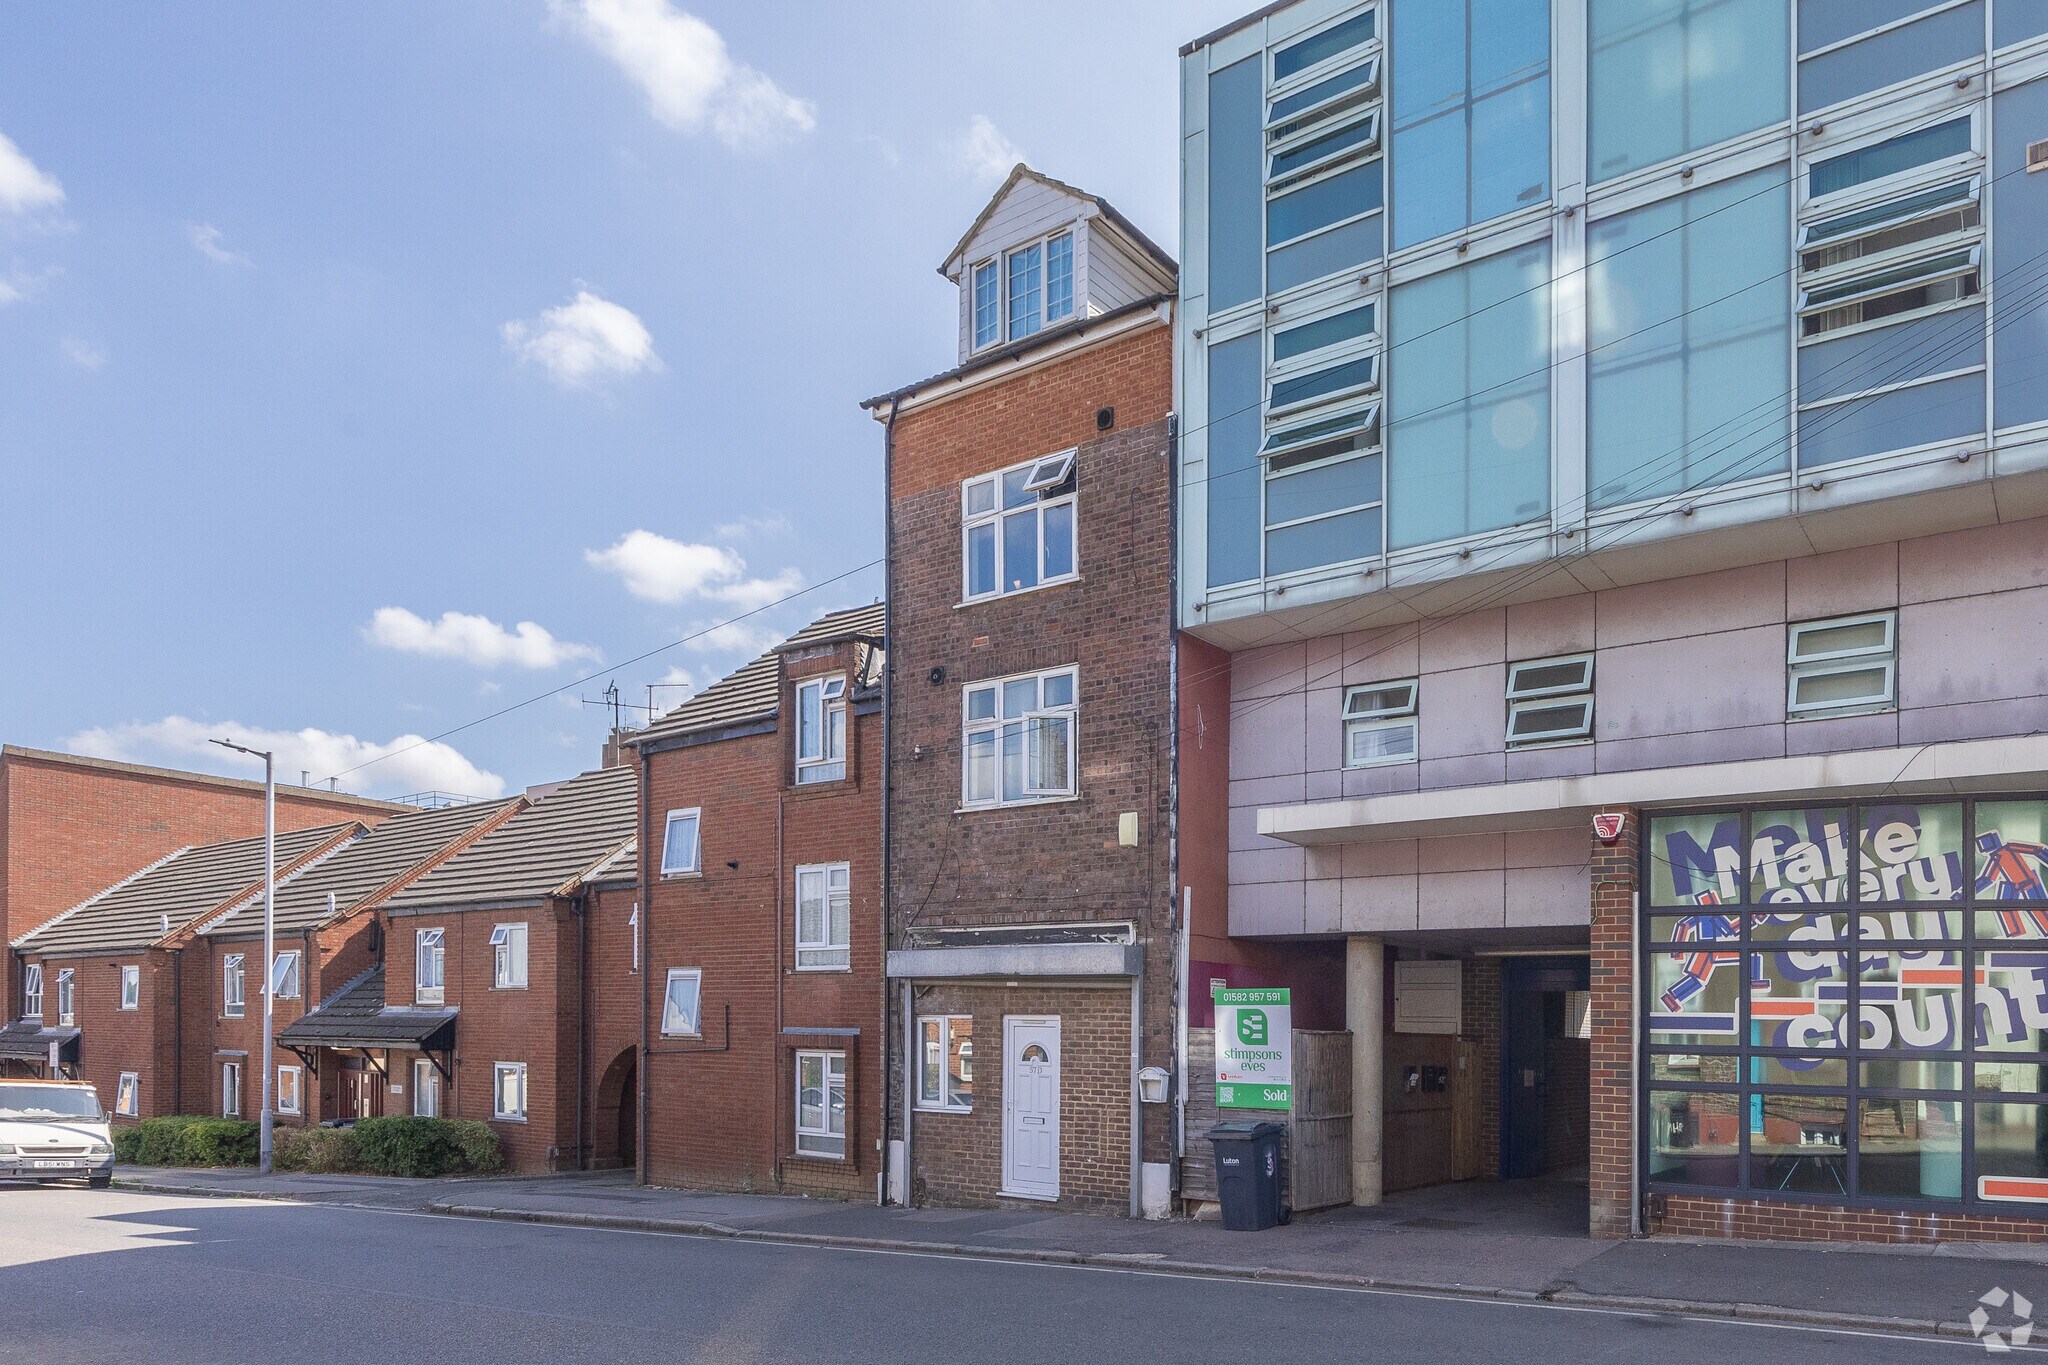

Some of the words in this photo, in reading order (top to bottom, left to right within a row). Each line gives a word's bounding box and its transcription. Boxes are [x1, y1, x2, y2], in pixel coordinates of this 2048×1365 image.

[1713, 822, 1919, 899] Make
[1768, 855, 1953, 922] every
[1787, 908, 1944, 971] day
[1223, 992, 1247, 1002] 01582
[1249, 992, 1265, 1002] 957
[1266, 992, 1281, 1002] 591
[1224, 1048, 1283, 1062] stimpsons
[1240, 1062, 1266, 1072] eves
[1263, 1089, 1287, 1102] Sold
